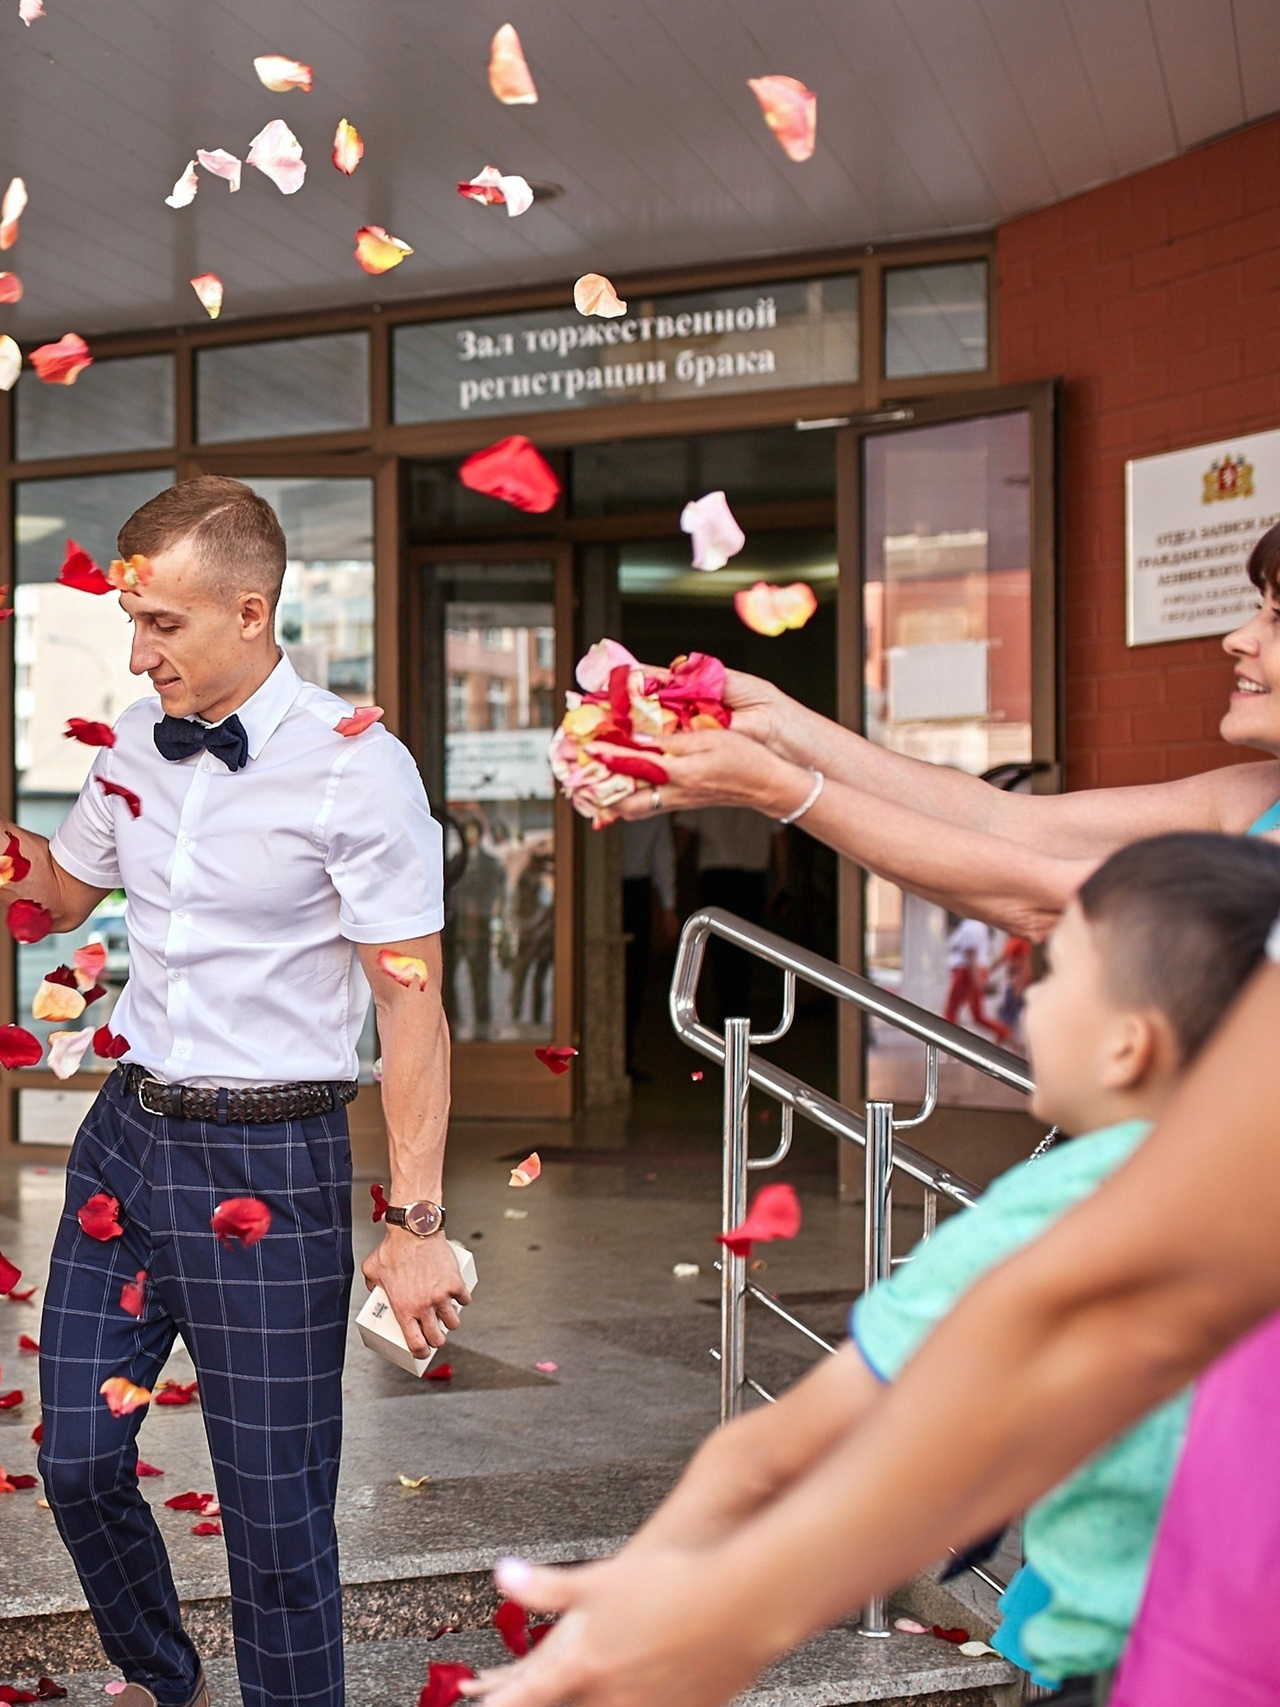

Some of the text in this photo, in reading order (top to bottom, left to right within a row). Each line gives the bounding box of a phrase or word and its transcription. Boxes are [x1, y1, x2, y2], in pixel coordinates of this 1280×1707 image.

[457, 297, 778, 361] Зал торжественной
[460, 348, 776, 408] регистрации брака
